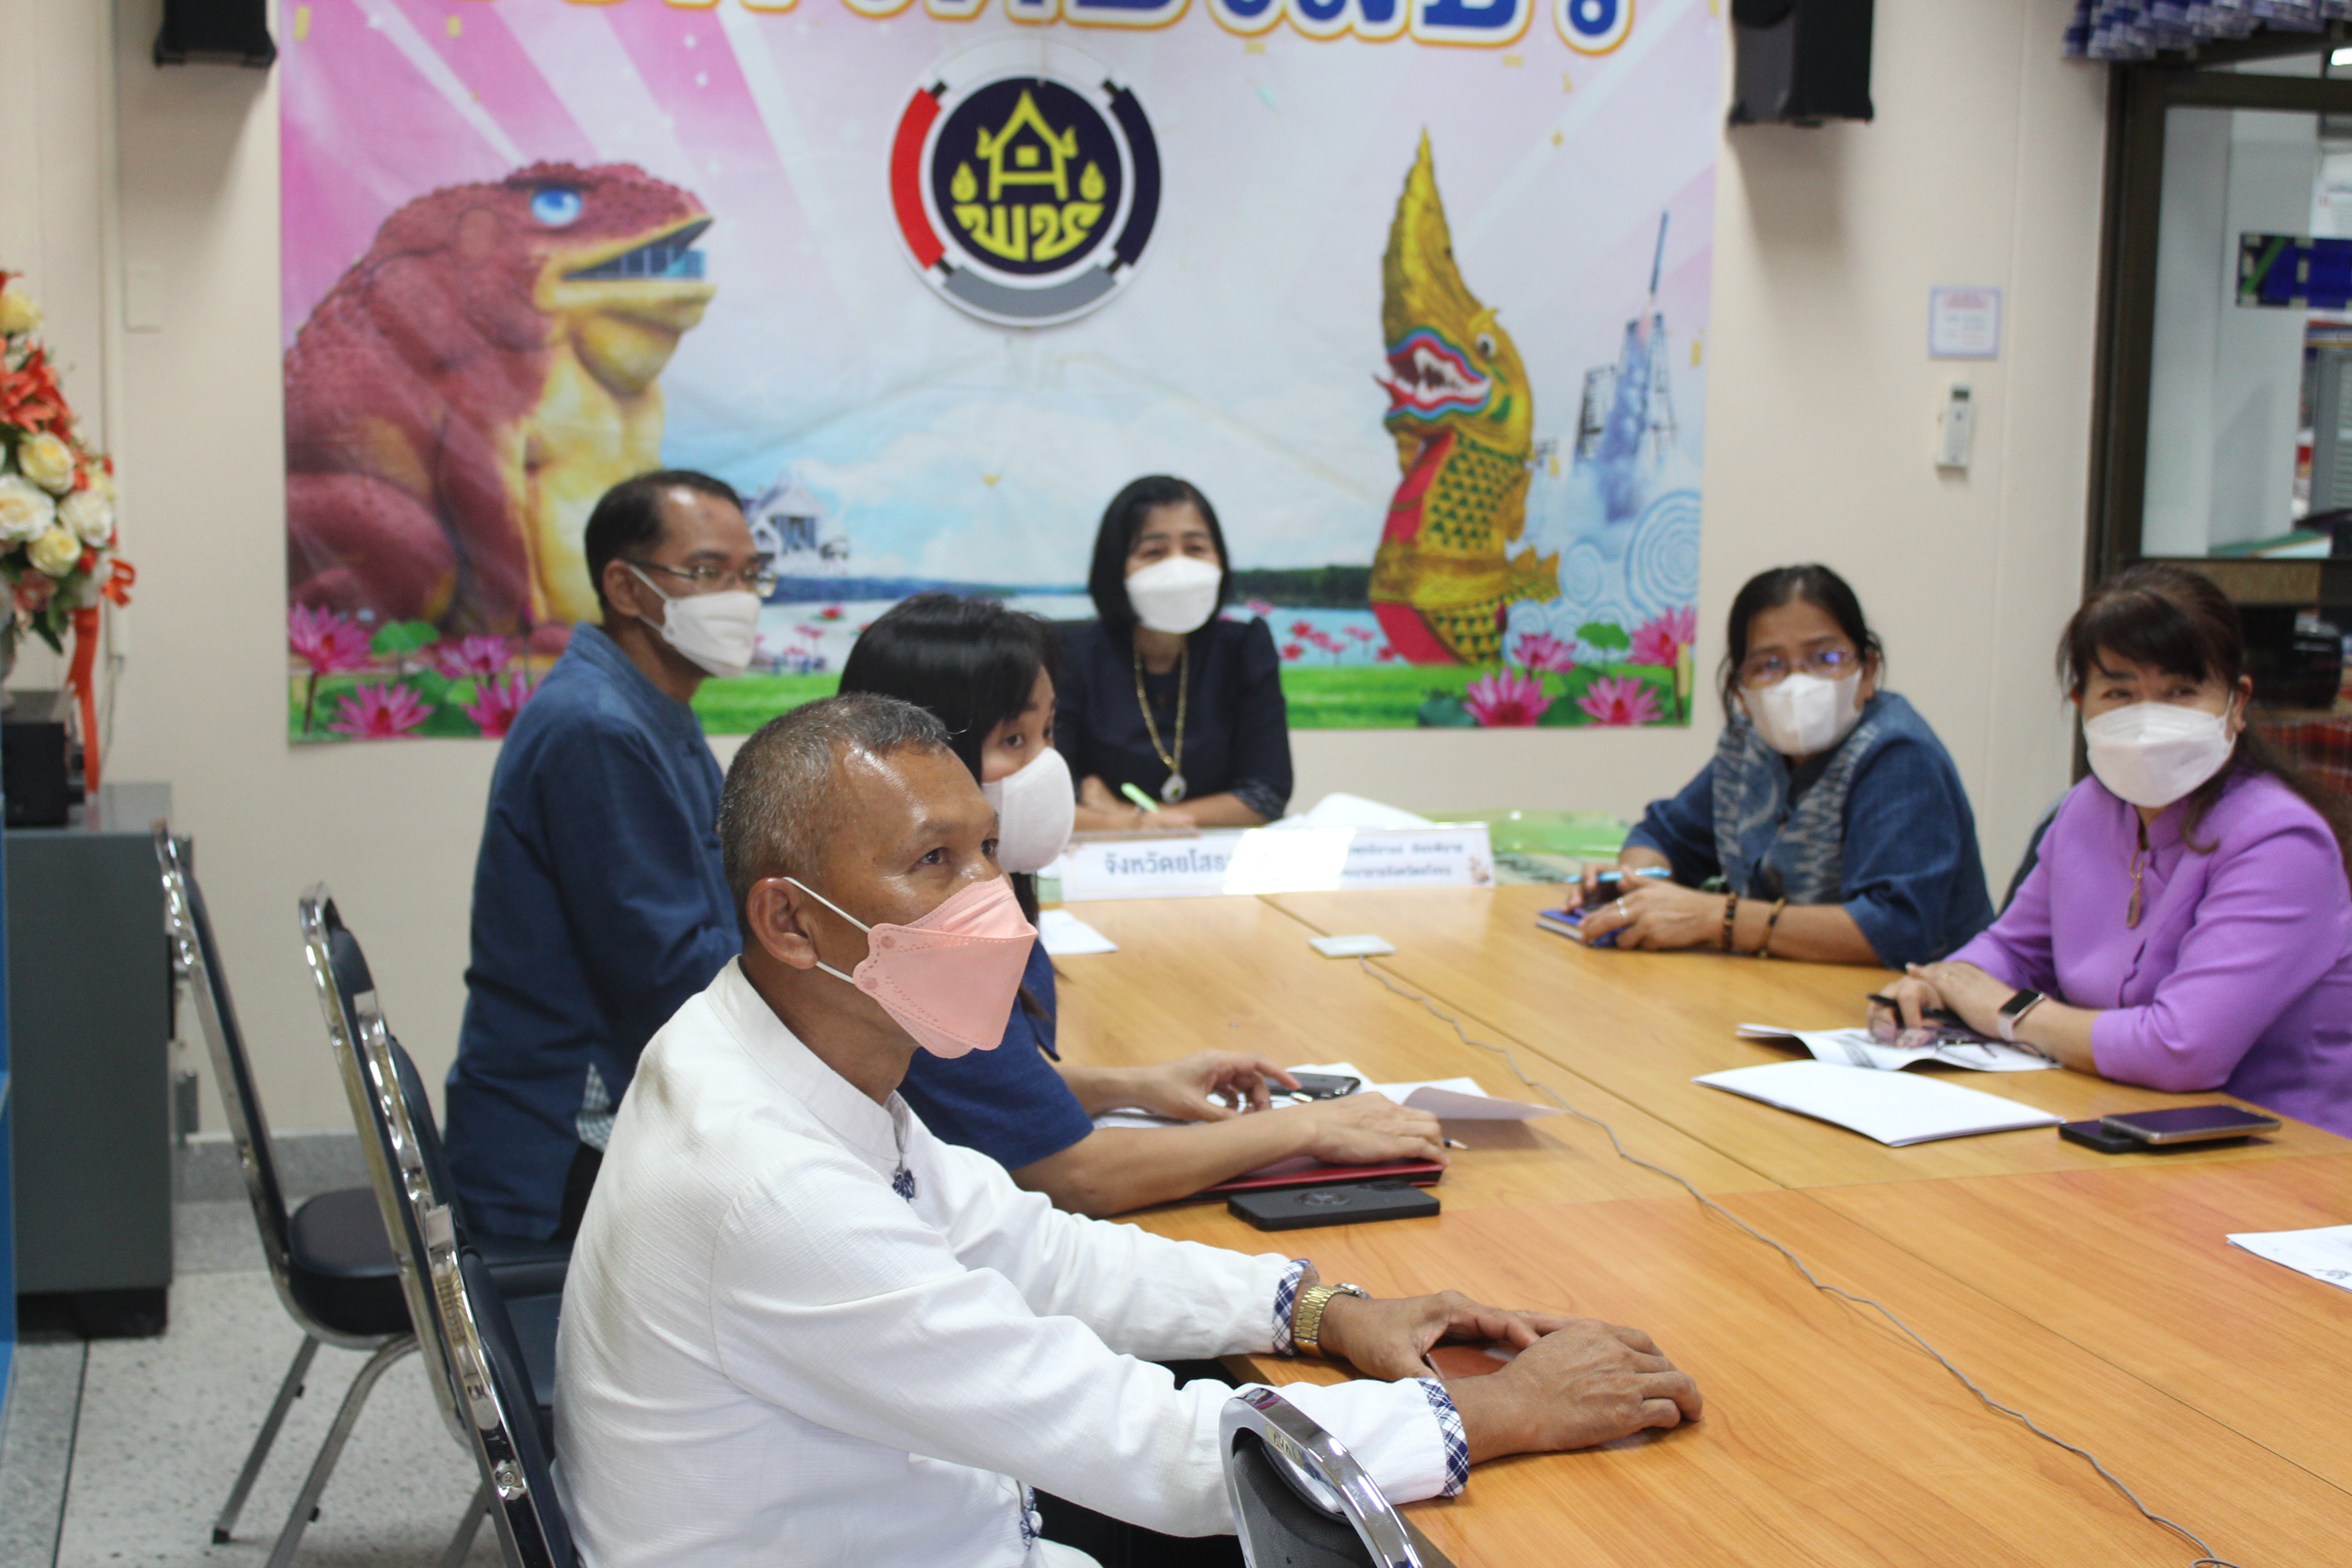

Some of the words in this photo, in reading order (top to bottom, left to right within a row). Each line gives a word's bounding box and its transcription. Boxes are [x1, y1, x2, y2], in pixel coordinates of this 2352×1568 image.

[1104, 848, 1231, 875] จังหวัดยโสธ
